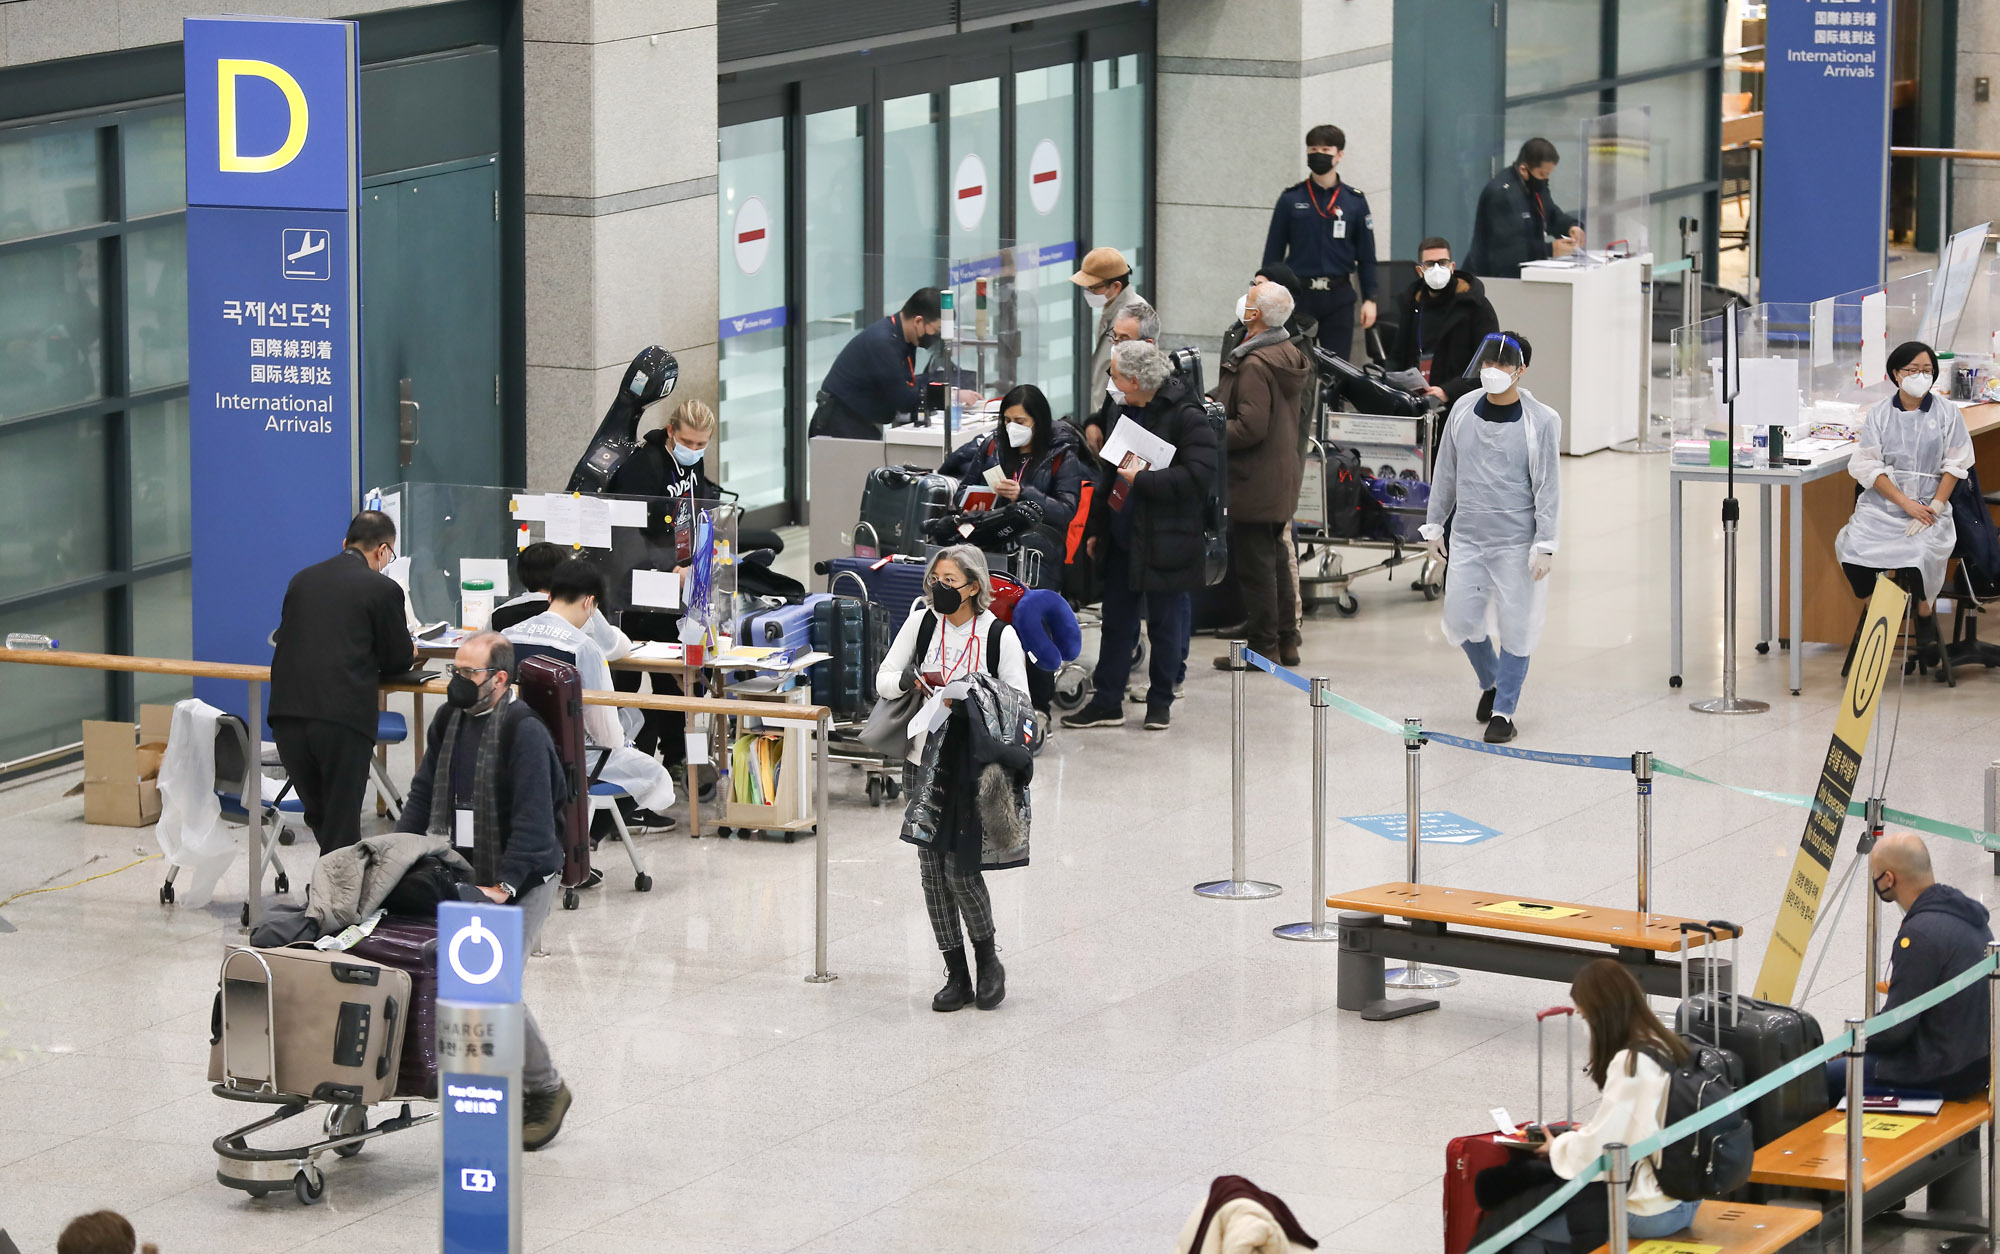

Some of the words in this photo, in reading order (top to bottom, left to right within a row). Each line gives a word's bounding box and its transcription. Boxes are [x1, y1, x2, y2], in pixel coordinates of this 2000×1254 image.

[1787, 49, 1876, 63] International
[1823, 64, 1875, 78] Arrivals
[218, 59, 309, 173] D
[223, 300, 331, 329] 국제선도착
[250, 338, 332, 360] 国際線到着
[250, 364, 332, 385] 国际线到达
[215, 392, 333, 412] International
[264, 415, 333, 433] Arrivals
[527, 623, 574, 640] 검역지원단
[1818, 783, 1828, 806] Only
[1825, 789, 1847, 819] beverages
[1814, 809, 1822, 824] are
[1820, 812, 1839, 836] allowed
